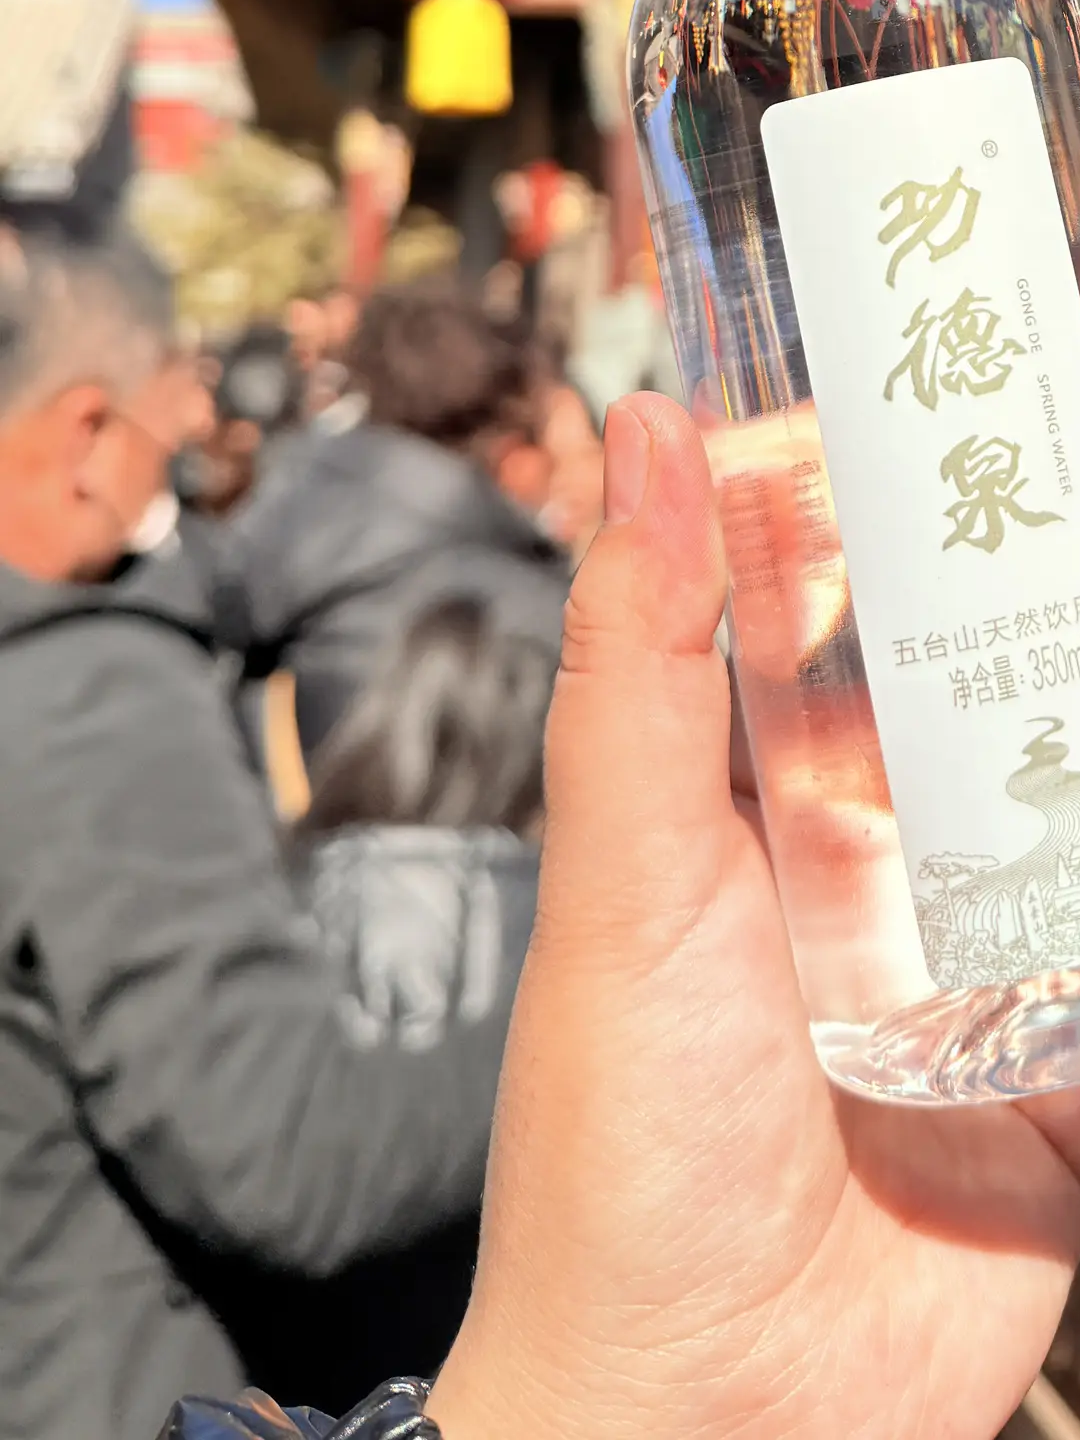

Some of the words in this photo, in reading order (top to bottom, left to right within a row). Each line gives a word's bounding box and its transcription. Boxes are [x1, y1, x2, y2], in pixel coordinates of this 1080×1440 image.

[877, 166, 1067, 554] 功德泉
[1016, 278, 1037, 326] GONG
[1028, 333, 1043, 353] DE
[1037, 374, 1060, 435] SPRING
[1052, 438, 1073, 496] WATER
